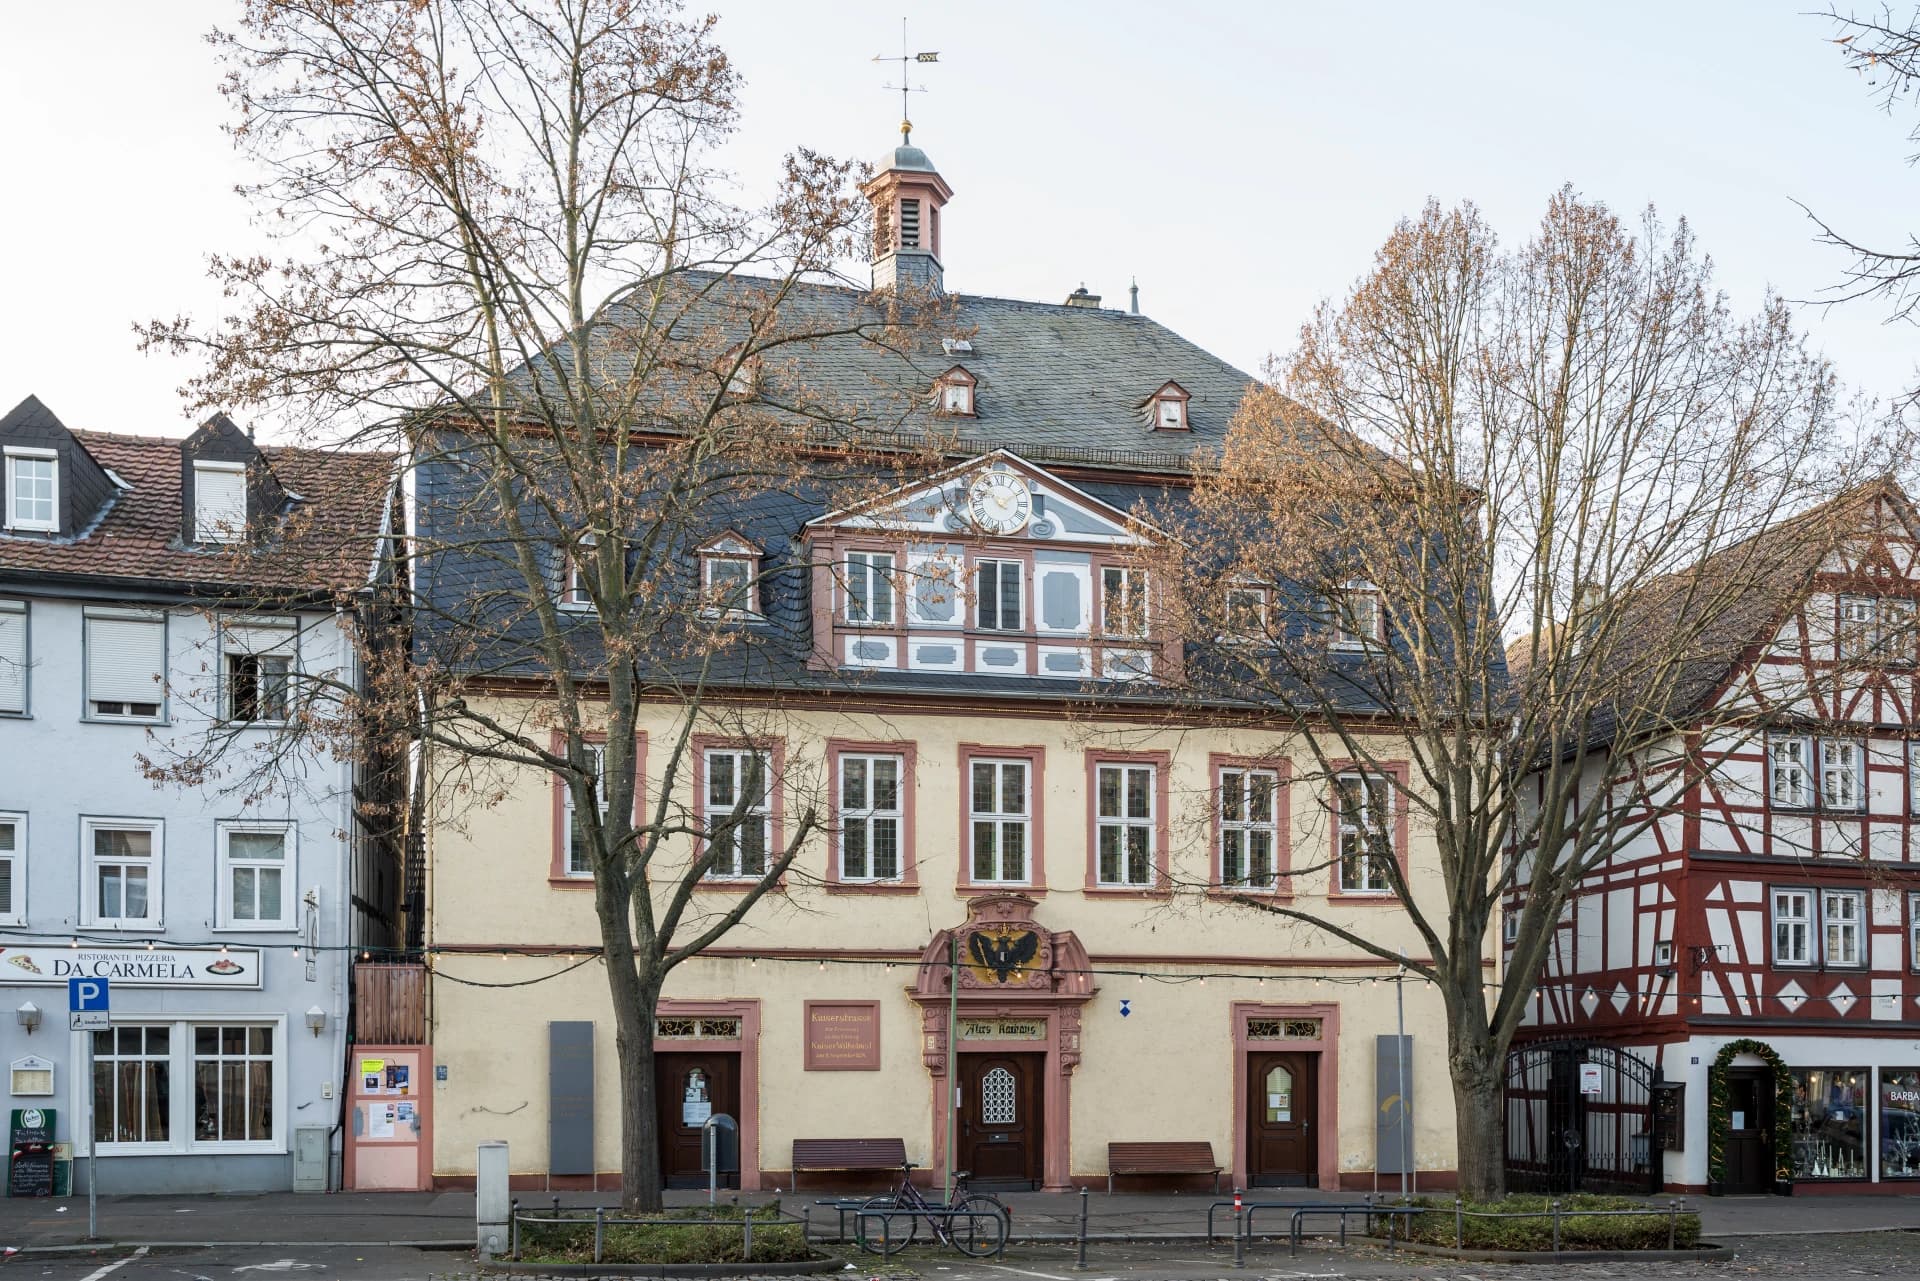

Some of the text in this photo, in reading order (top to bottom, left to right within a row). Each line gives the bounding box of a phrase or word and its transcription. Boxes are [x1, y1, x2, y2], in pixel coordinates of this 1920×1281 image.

[78, 953, 176, 962] RISTORANTE PIZZERIA
[53, 959, 195, 978] DA CARMELA
[78, 982, 100, 1010] P
[998, 1022, 1036, 1035] Rathaus
